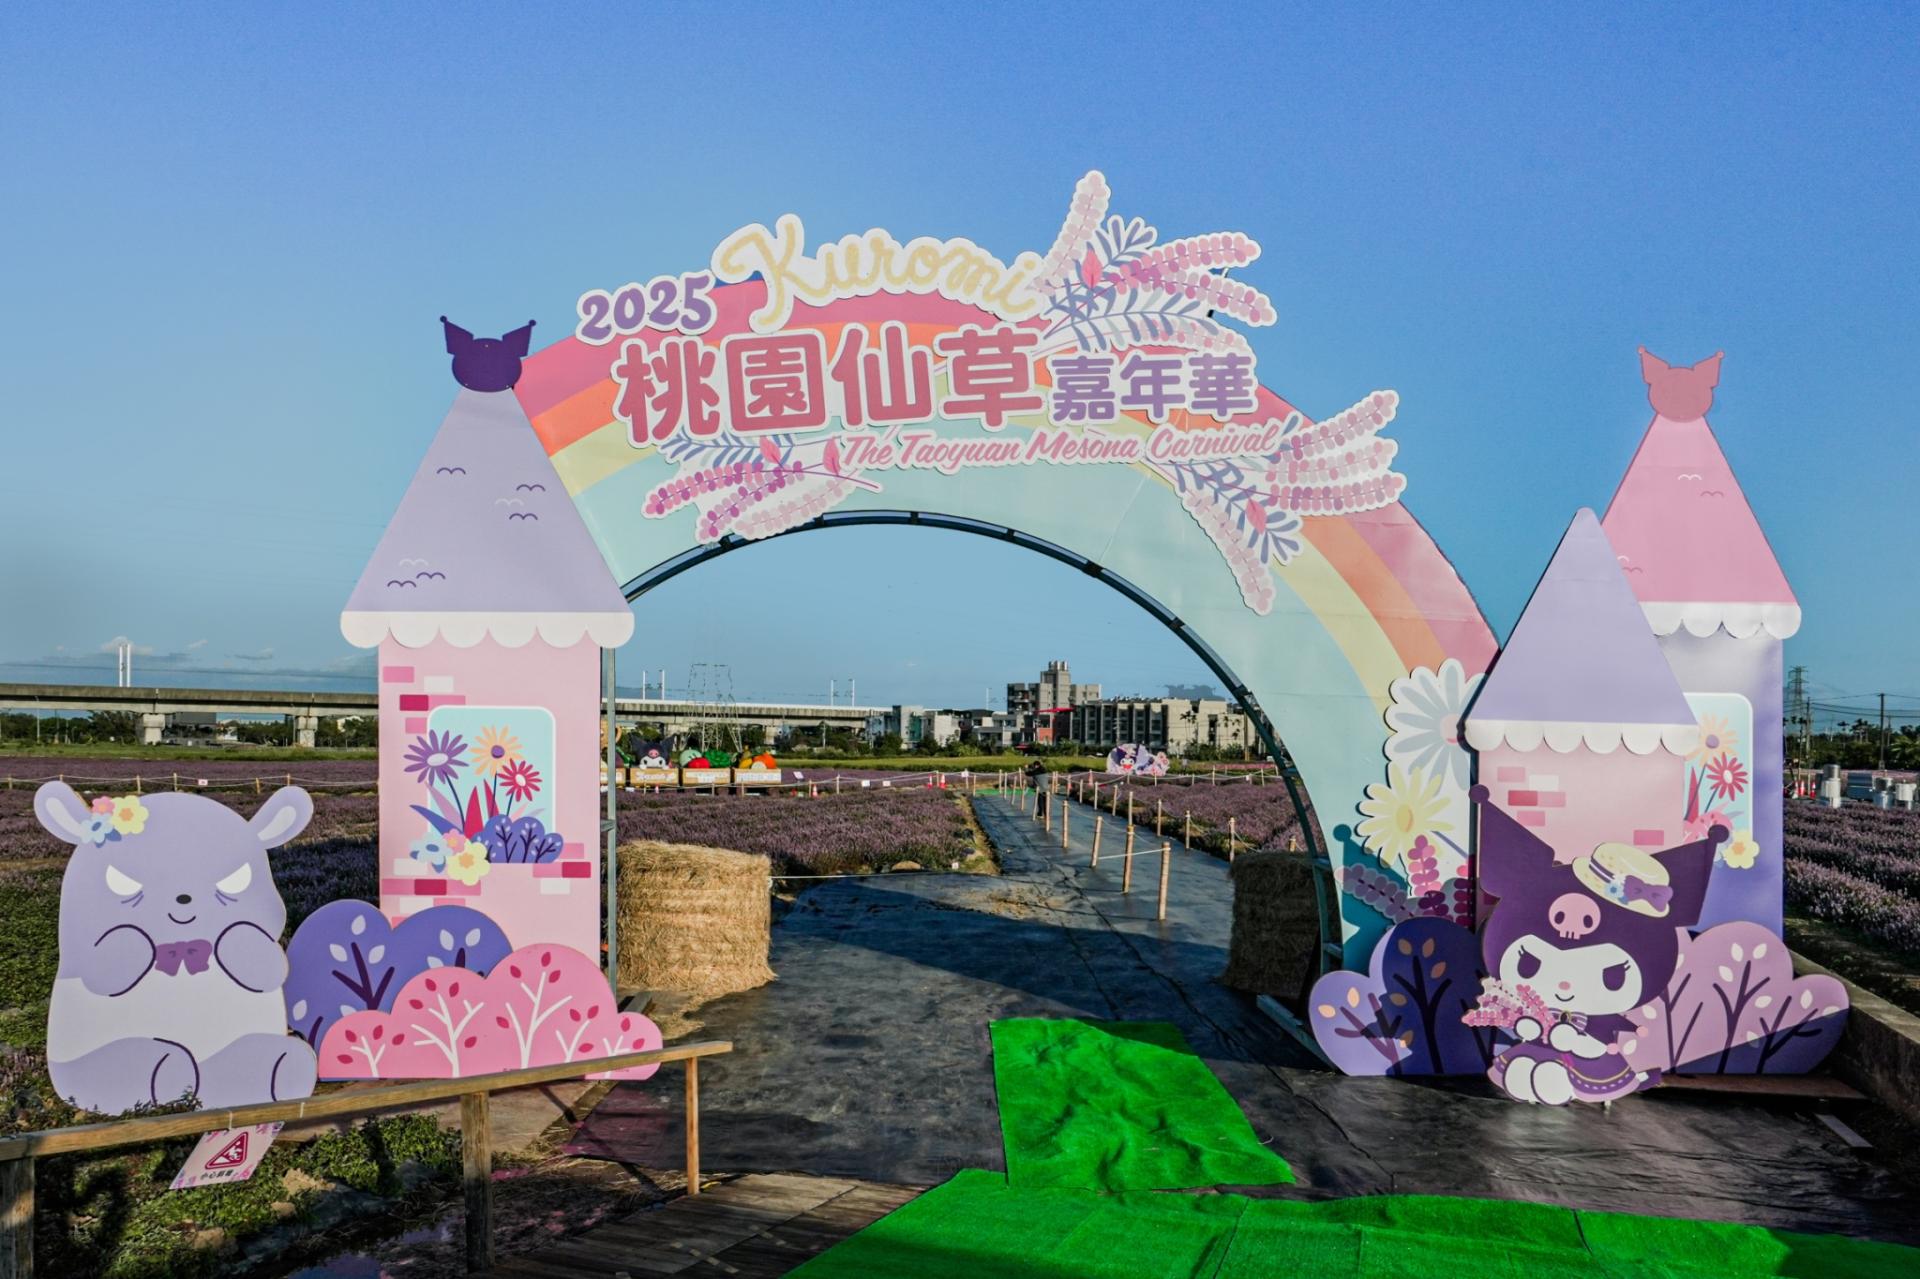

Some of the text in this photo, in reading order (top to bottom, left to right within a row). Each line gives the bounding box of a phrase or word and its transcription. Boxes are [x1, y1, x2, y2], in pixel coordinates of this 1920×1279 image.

[580, 222, 1037, 341] 2025 Kuromi
[615, 326, 1254, 443] 桃園仙草 嘉年華
[844, 423, 1280, 471] The Taoyuan Mesona Carnival
